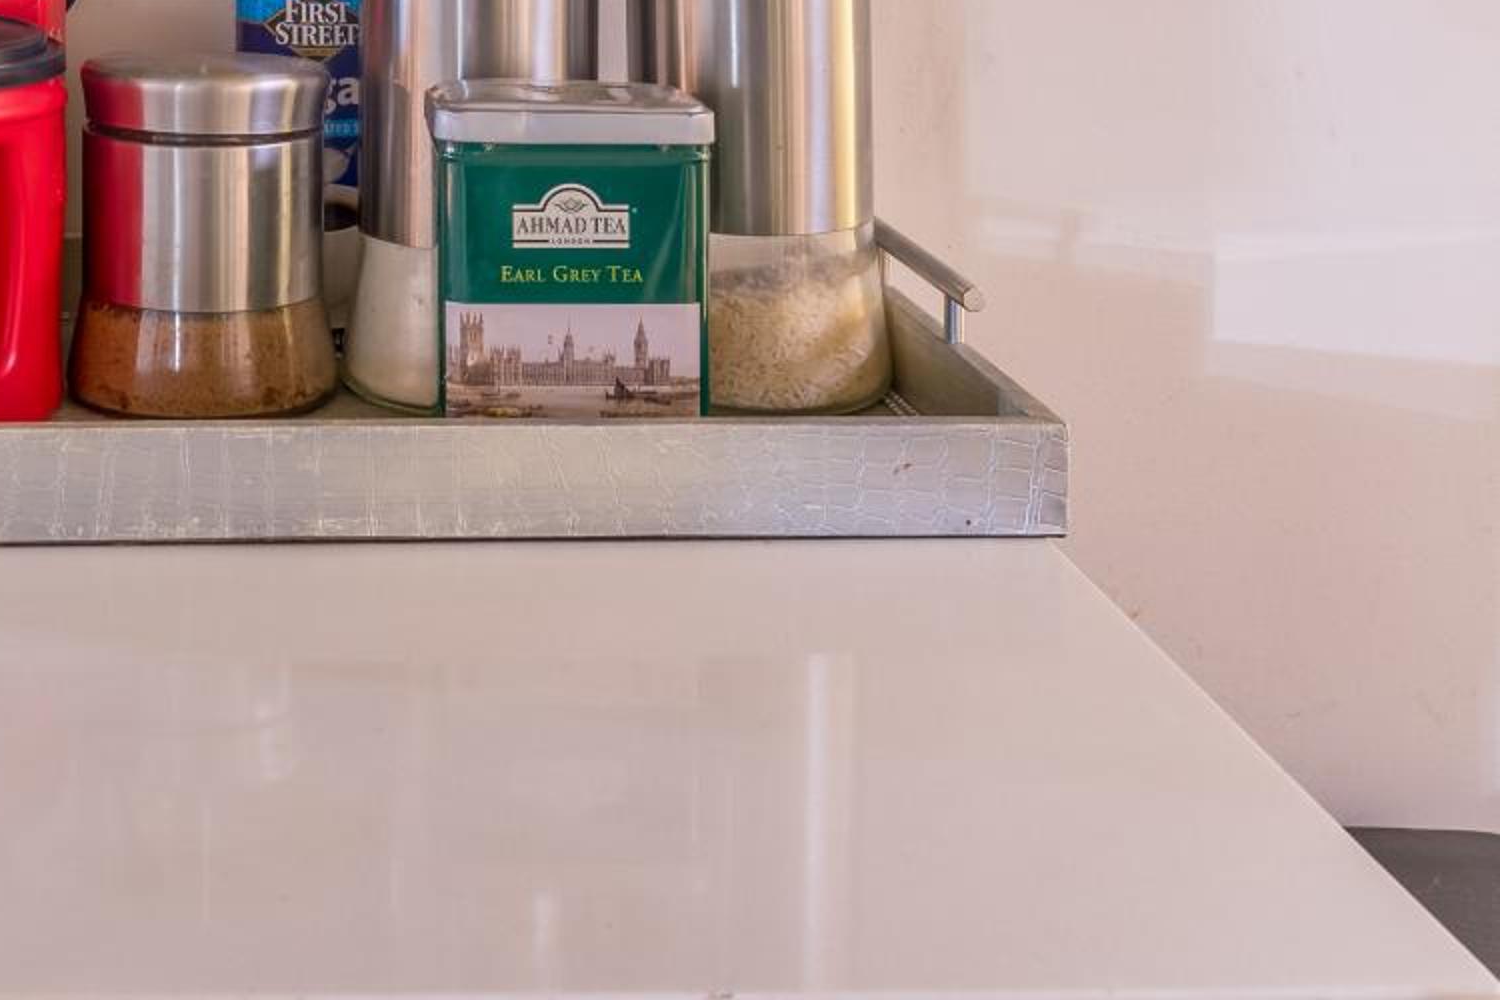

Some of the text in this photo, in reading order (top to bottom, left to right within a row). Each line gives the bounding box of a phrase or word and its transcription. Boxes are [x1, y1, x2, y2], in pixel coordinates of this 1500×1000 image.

[275, 22, 359, 46] STREET
[516, 216, 626, 234] AHMAD TEA
